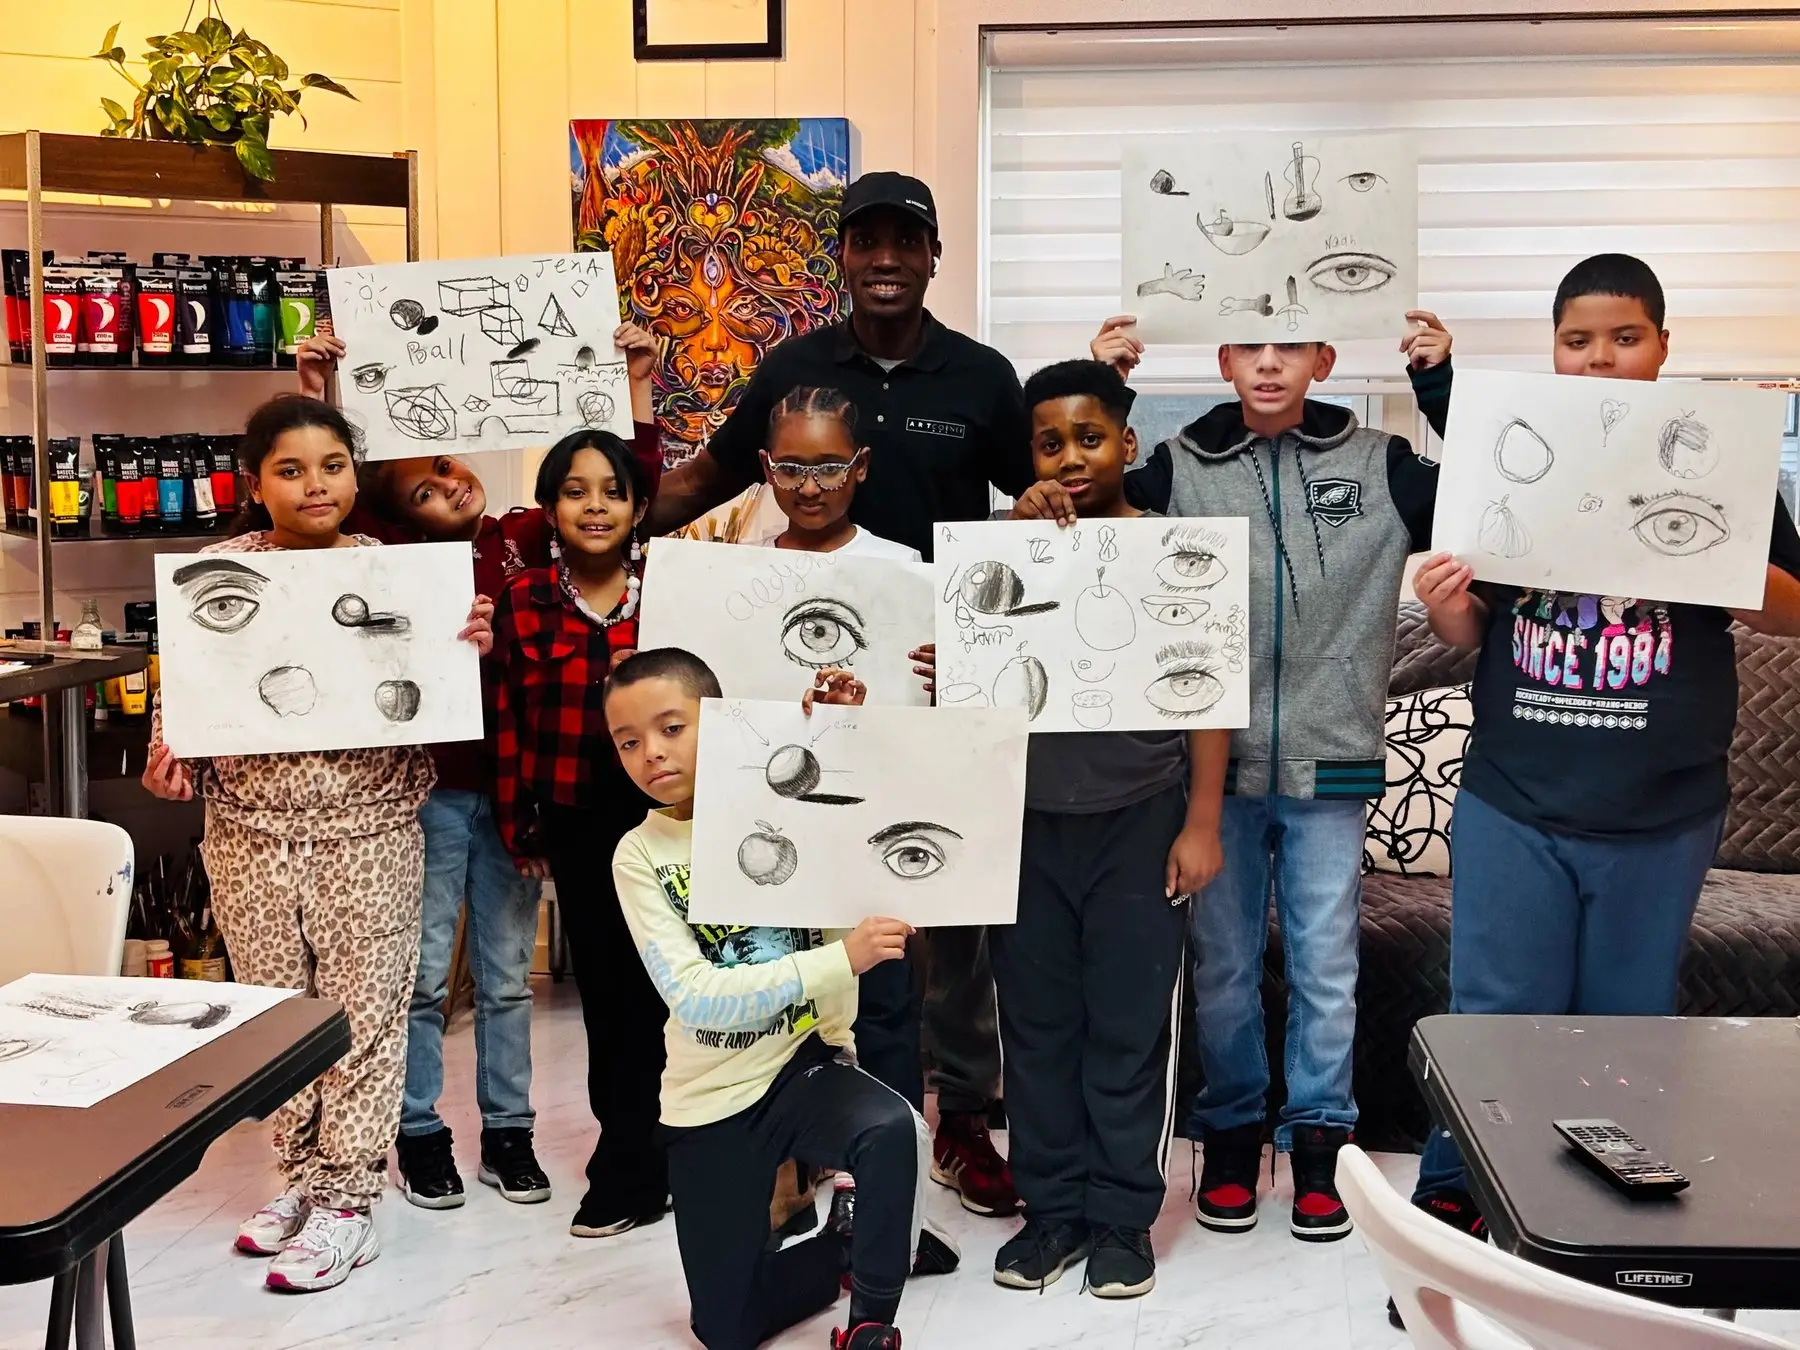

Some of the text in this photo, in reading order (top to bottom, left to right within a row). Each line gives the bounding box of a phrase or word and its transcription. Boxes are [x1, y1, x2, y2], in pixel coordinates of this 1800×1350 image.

[406, 333, 466, 367] Ball
[1512, 614, 1673, 691] SINCE 1984
[696, 1028, 756, 1050] SURF AND
[1624, 1273, 1684, 1284] LIFETIME
